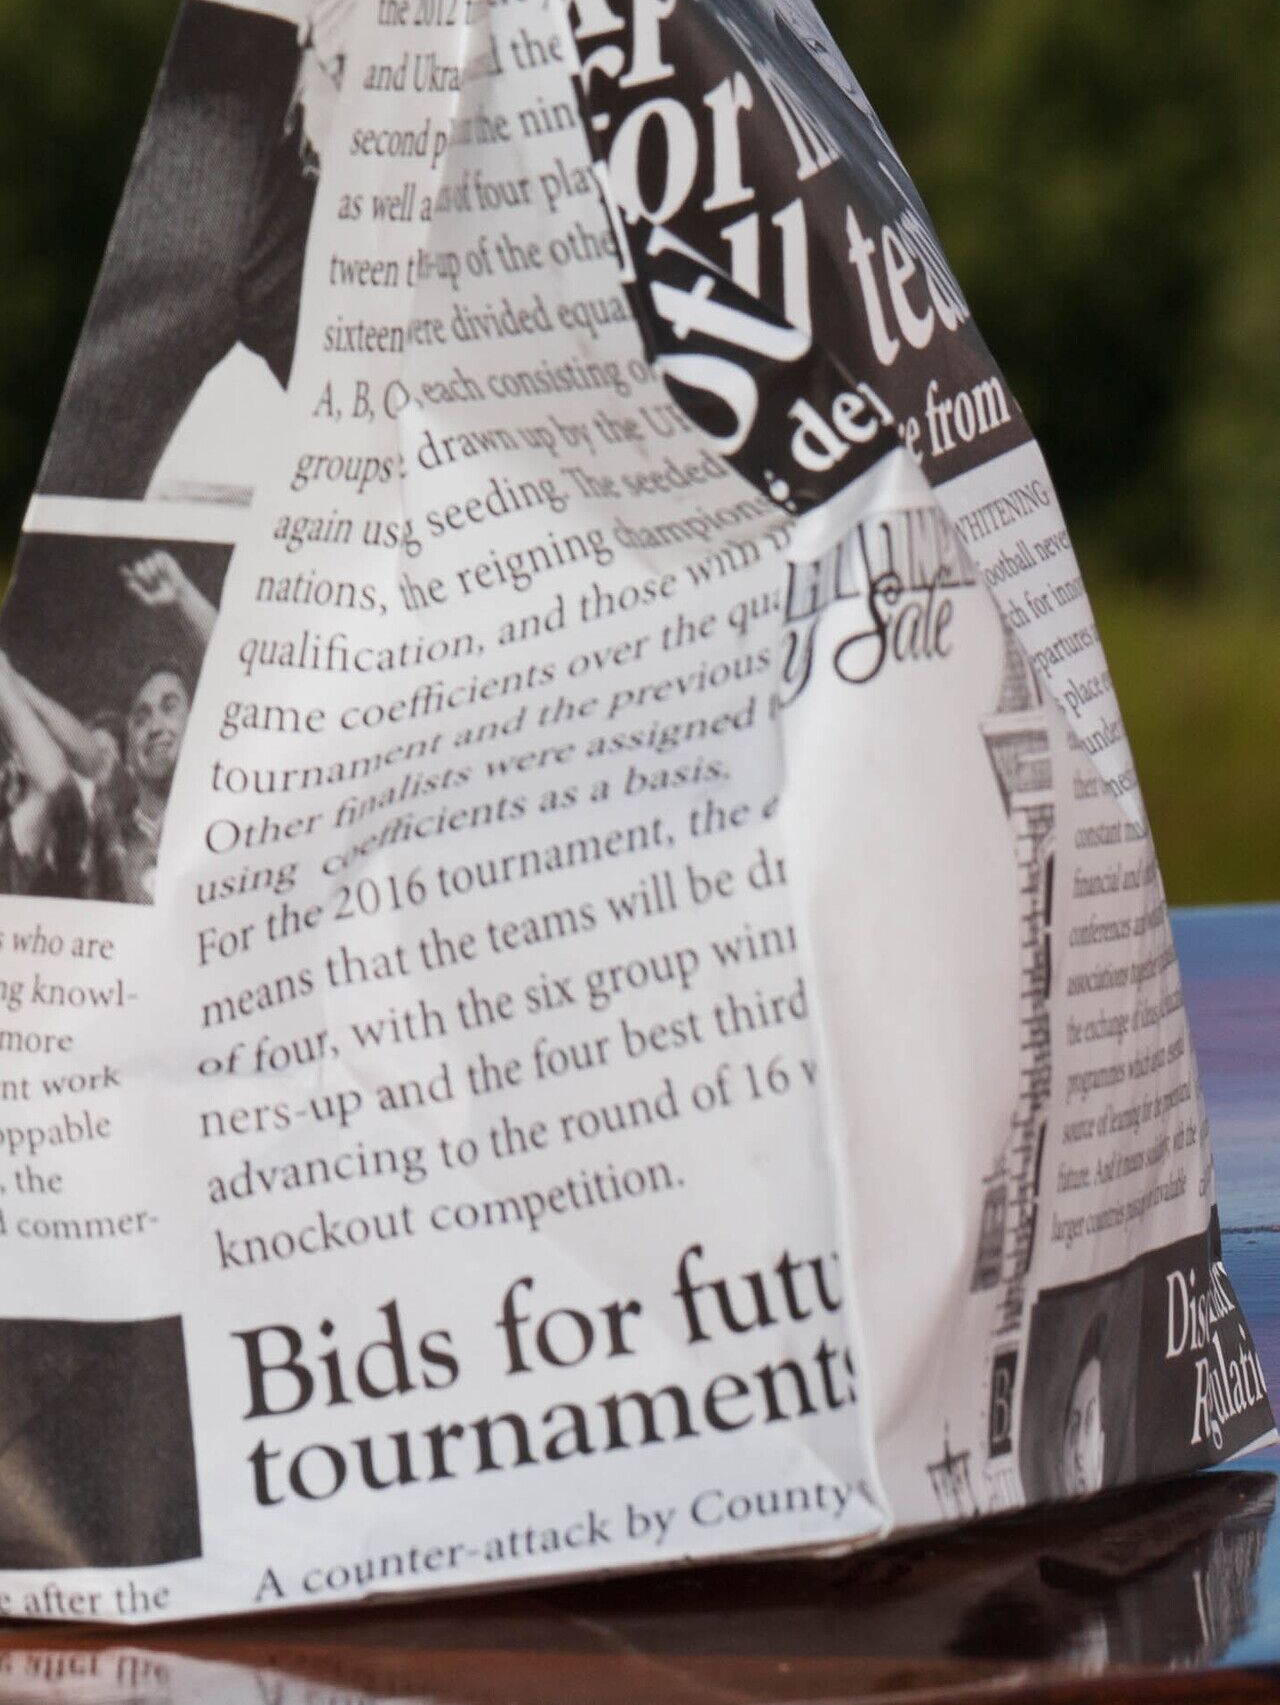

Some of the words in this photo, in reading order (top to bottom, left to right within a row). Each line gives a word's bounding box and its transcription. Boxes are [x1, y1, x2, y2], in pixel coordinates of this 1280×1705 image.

[364, 53, 407, 90] and
[510, 28, 564, 70] the
[350, 118, 431, 157] second
[338, 194, 363, 221] as
[372, 182, 417, 221] well
[329, 253, 398, 287] tween
[466, 235, 497, 277] of
[500, 232, 541, 270] the
[324, 316, 404, 353] sixteen
[451, 295, 553, 344] divided
[312, 380, 342, 422] A,
[352, 379, 375, 422] B,
[421, 366, 485, 404] each
[487, 356, 622, 403] consisting
[926, 376, 1012, 457] from
[290, 454, 393, 494] groups
[417, 428, 517, 472] drawn
[559, 419, 594, 455] by
[595, 408, 642, 444] the
[273, 512, 353, 555] again
[426, 471, 570, 537] seeding.
[567, 463, 618, 500] The
[622, 450, 730, 496] seeded
[237, 627, 485, 681] qualification,
[496, 593, 567, 648] and
[579, 566, 679, 624] those
[685, 541, 762, 587] with
[254, 567, 389, 617] nations,
[399, 567, 448, 613] the
[457, 524, 615, 595] reigning
[1032, 586, 1055, 621] for
[219, 699, 327, 741] game
[339, 664, 555, 732] coefficients
[567, 632, 649, 680] over
[661, 602, 717, 651] the
[211, 731, 445, 796] tournament
[452, 705, 527, 749] and
[537, 686, 599, 730] the
[605, 646, 772, 721] previous
[204, 808, 324, 856] Other
[334, 763, 471, 830] finalists
[484, 743, 576, 779] were
[585, 695, 757, 759] assigned
[194, 861, 301, 907] using
[320, 792, 527, 878] coefficients
[537, 789, 579, 815] as
[589, 779, 611, 805] a
[622, 753, 733, 796] basis.
[195, 924, 255, 968] For
[266, 901, 324, 946] the
[334, 866, 429, 922] 2016
[437, 820, 677, 899] tournament,
[687, 797, 758, 841] the
[12, 923, 64, 957] who
[70, 932, 116, 961] are
[200, 965, 316, 1030] means
[325, 941, 411, 989] that
[418, 924, 479, 973] the
[486, 900, 599, 956] teams
[606, 864, 679, 920] will
[685, 859, 736, 897] be
[32, 974, 138, 1009] knowl-
[195, 1047, 245, 1079] of
[253, 1028, 342, 1077] four,
[349, 1003, 449, 1052] with
[453, 984, 516, 1033] the
[523, 976, 576, 1014] six
[583, 946, 702, 1014] group
[41, 1065, 122, 1096] work
[198, 1088, 365, 1140] ners-up
[377, 1064, 454, 1114] and
[466, 1050, 526, 1096] the
[529, 1035, 613, 1080] four
[619, 1012, 706, 1061] best
[714, 976, 810, 1038] third
[205, 1141, 429, 1208] advancing
[438, 1136, 481, 1172] to
[488, 1115, 549, 1163] the
[559, 1077, 682, 1146] round
[690, 1066, 734, 1113] of
[745, 1055, 792, 1100] 16
[15, 1164, 64, 1195] the
[214, 1203, 418, 1273] knockout
[429, 1155, 686, 1234] competition.
[16, 1206, 160, 1241] commer-
[228, 1296, 461, 1425] Bids
[494, 1274, 642, 1378] for
[252, 1565, 289, 1606] A
[300, 1509, 614, 1596] counter-attack
[625, 1501, 677, 1548] by
[23, 1582, 105, 1618] after
[114, 1580, 171, 1617] the
